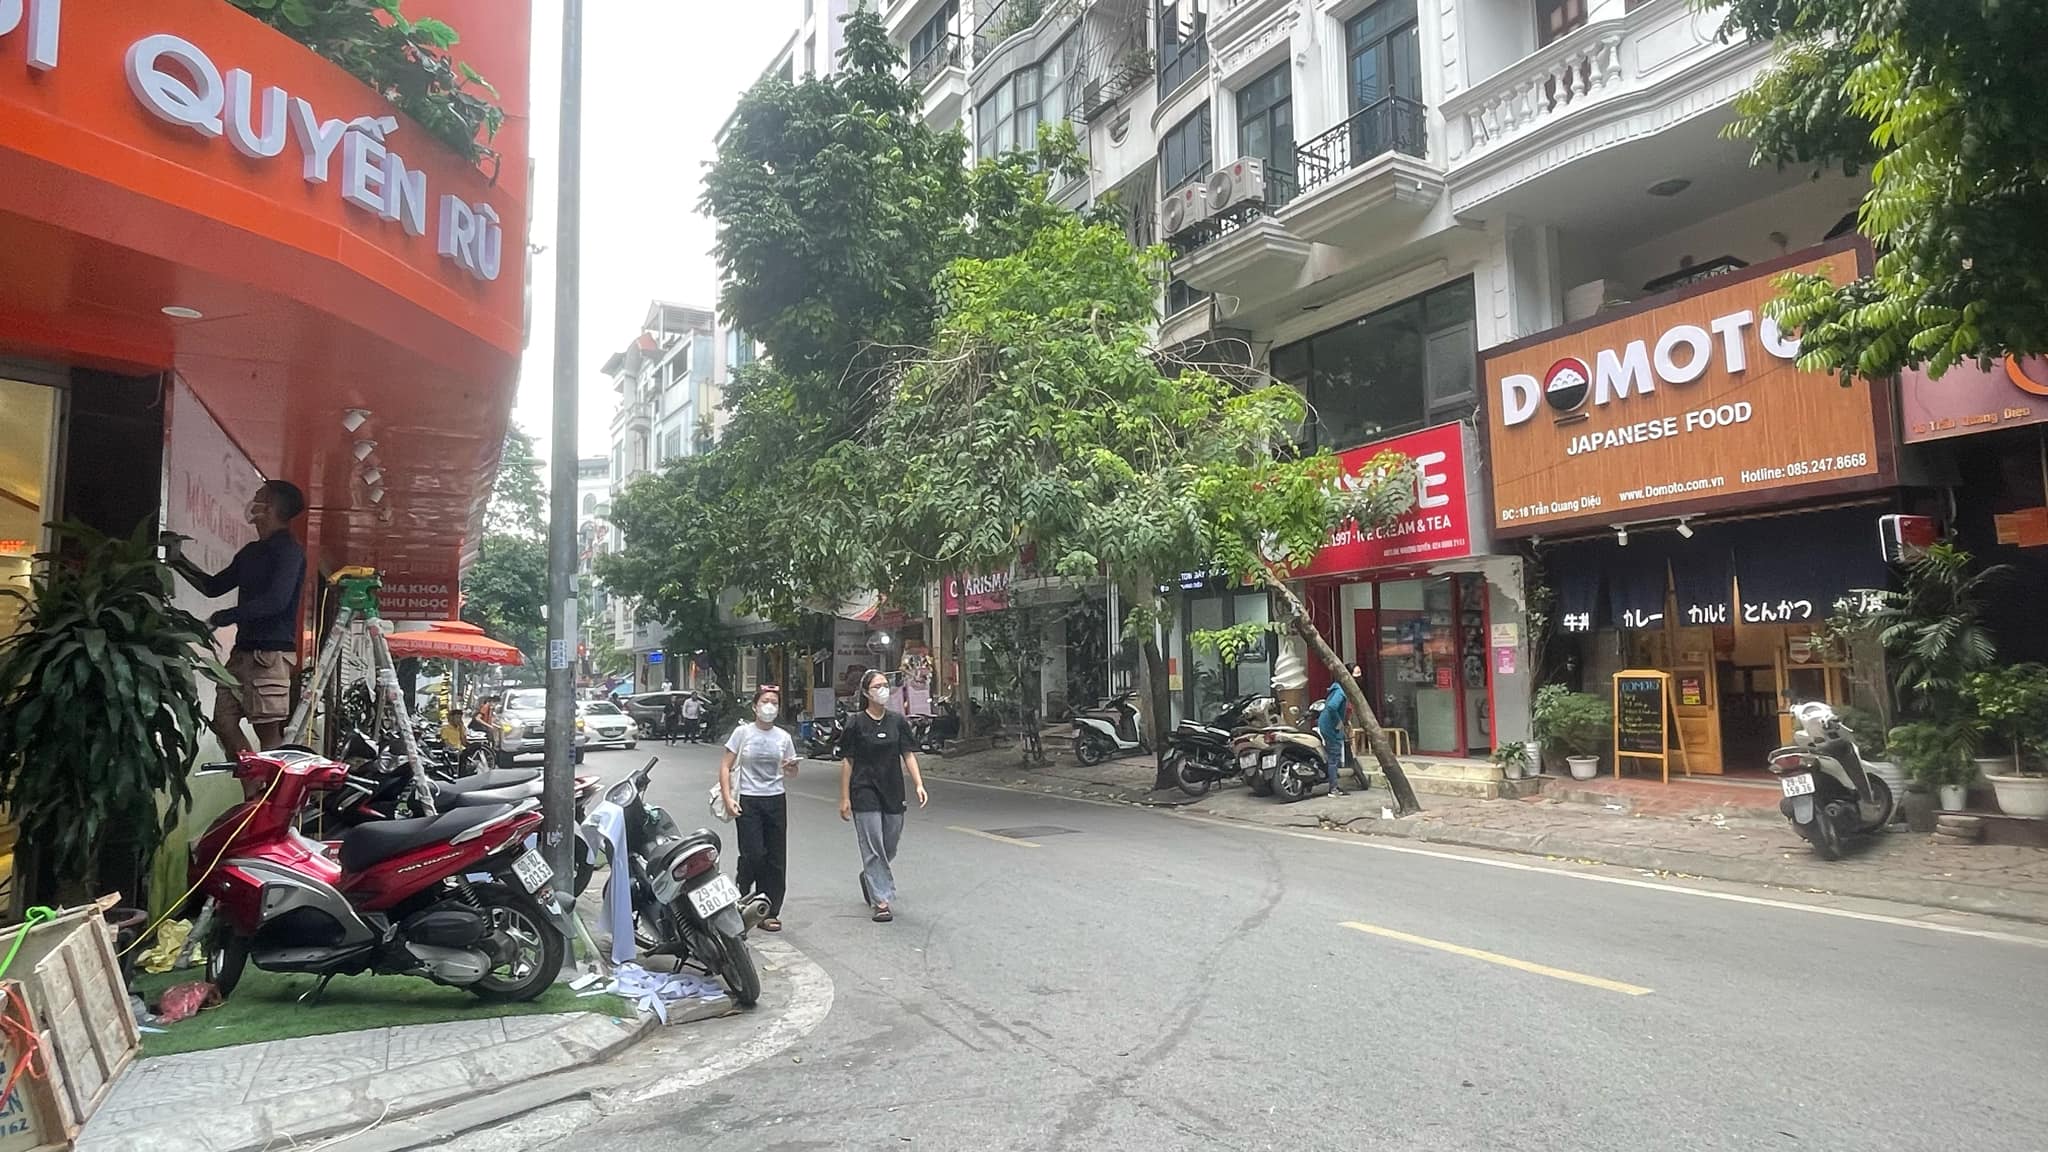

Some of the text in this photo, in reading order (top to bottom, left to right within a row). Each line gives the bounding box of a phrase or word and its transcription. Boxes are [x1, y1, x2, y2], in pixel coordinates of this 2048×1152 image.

[125, 34, 427, 236] QUYẾN
[1567, 401, 1753, 456] JAPANESE FOOD
[1741, 453, 1867, 484] Hotline: 085.247.8668
[1619, 476, 1725, 502] www.Domoto.com.vn
[1531, 501, 1550, 516] Trần
[1551, 500, 1579, 514] Quang
[1581, 494, 1602, 508] Diệu
[1332, 531, 1351, 547] 1997
[1417, 520, 1426, 532] &
[1427, 514, 1452, 531] TEA
[410, 584, 448, 594] KHOA
[950, 571, 1009, 598] CARISMA
[1623, 609, 1663, 628] カレー
[1744, 600, 1812, 622] とんかつ
